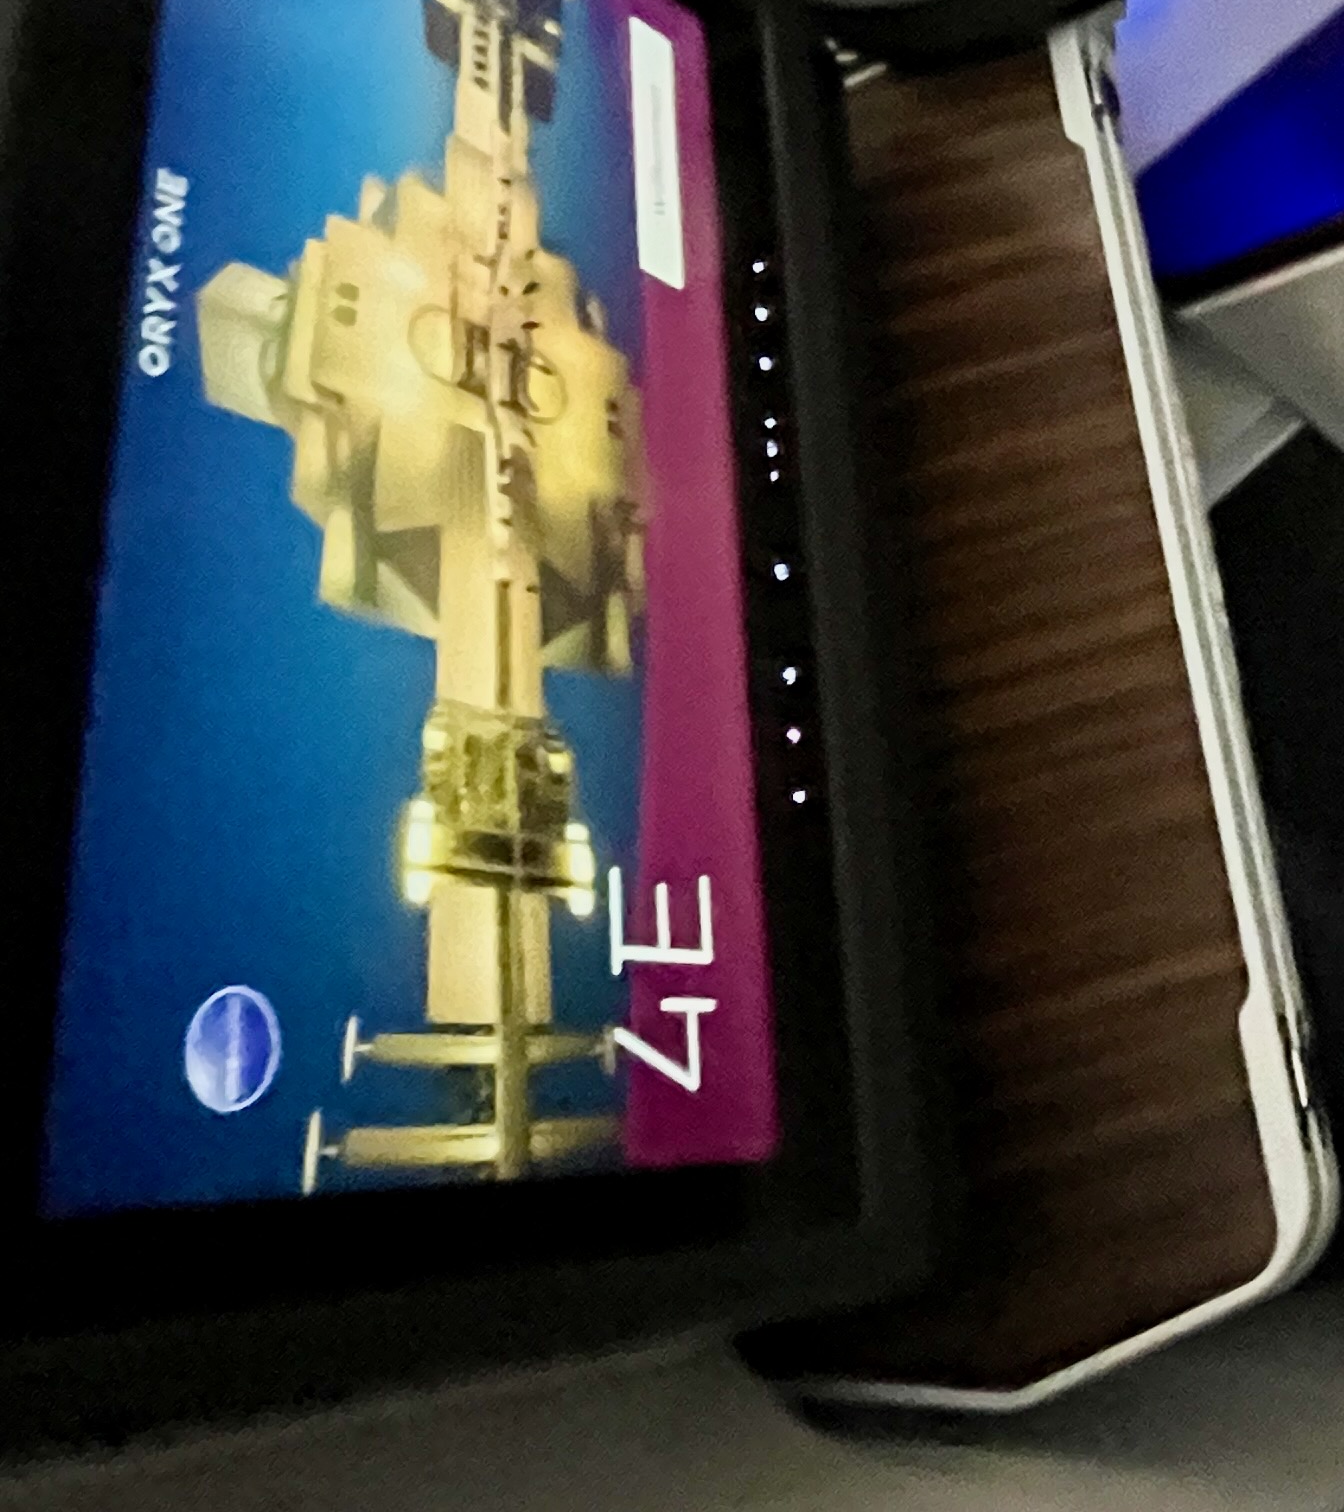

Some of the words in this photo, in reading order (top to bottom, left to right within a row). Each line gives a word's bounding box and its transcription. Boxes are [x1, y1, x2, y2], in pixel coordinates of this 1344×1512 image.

[152, 167, 189, 254] ONE
[138, 257, 182, 377] ORYX
[608, 865, 718, 1093] 4E
